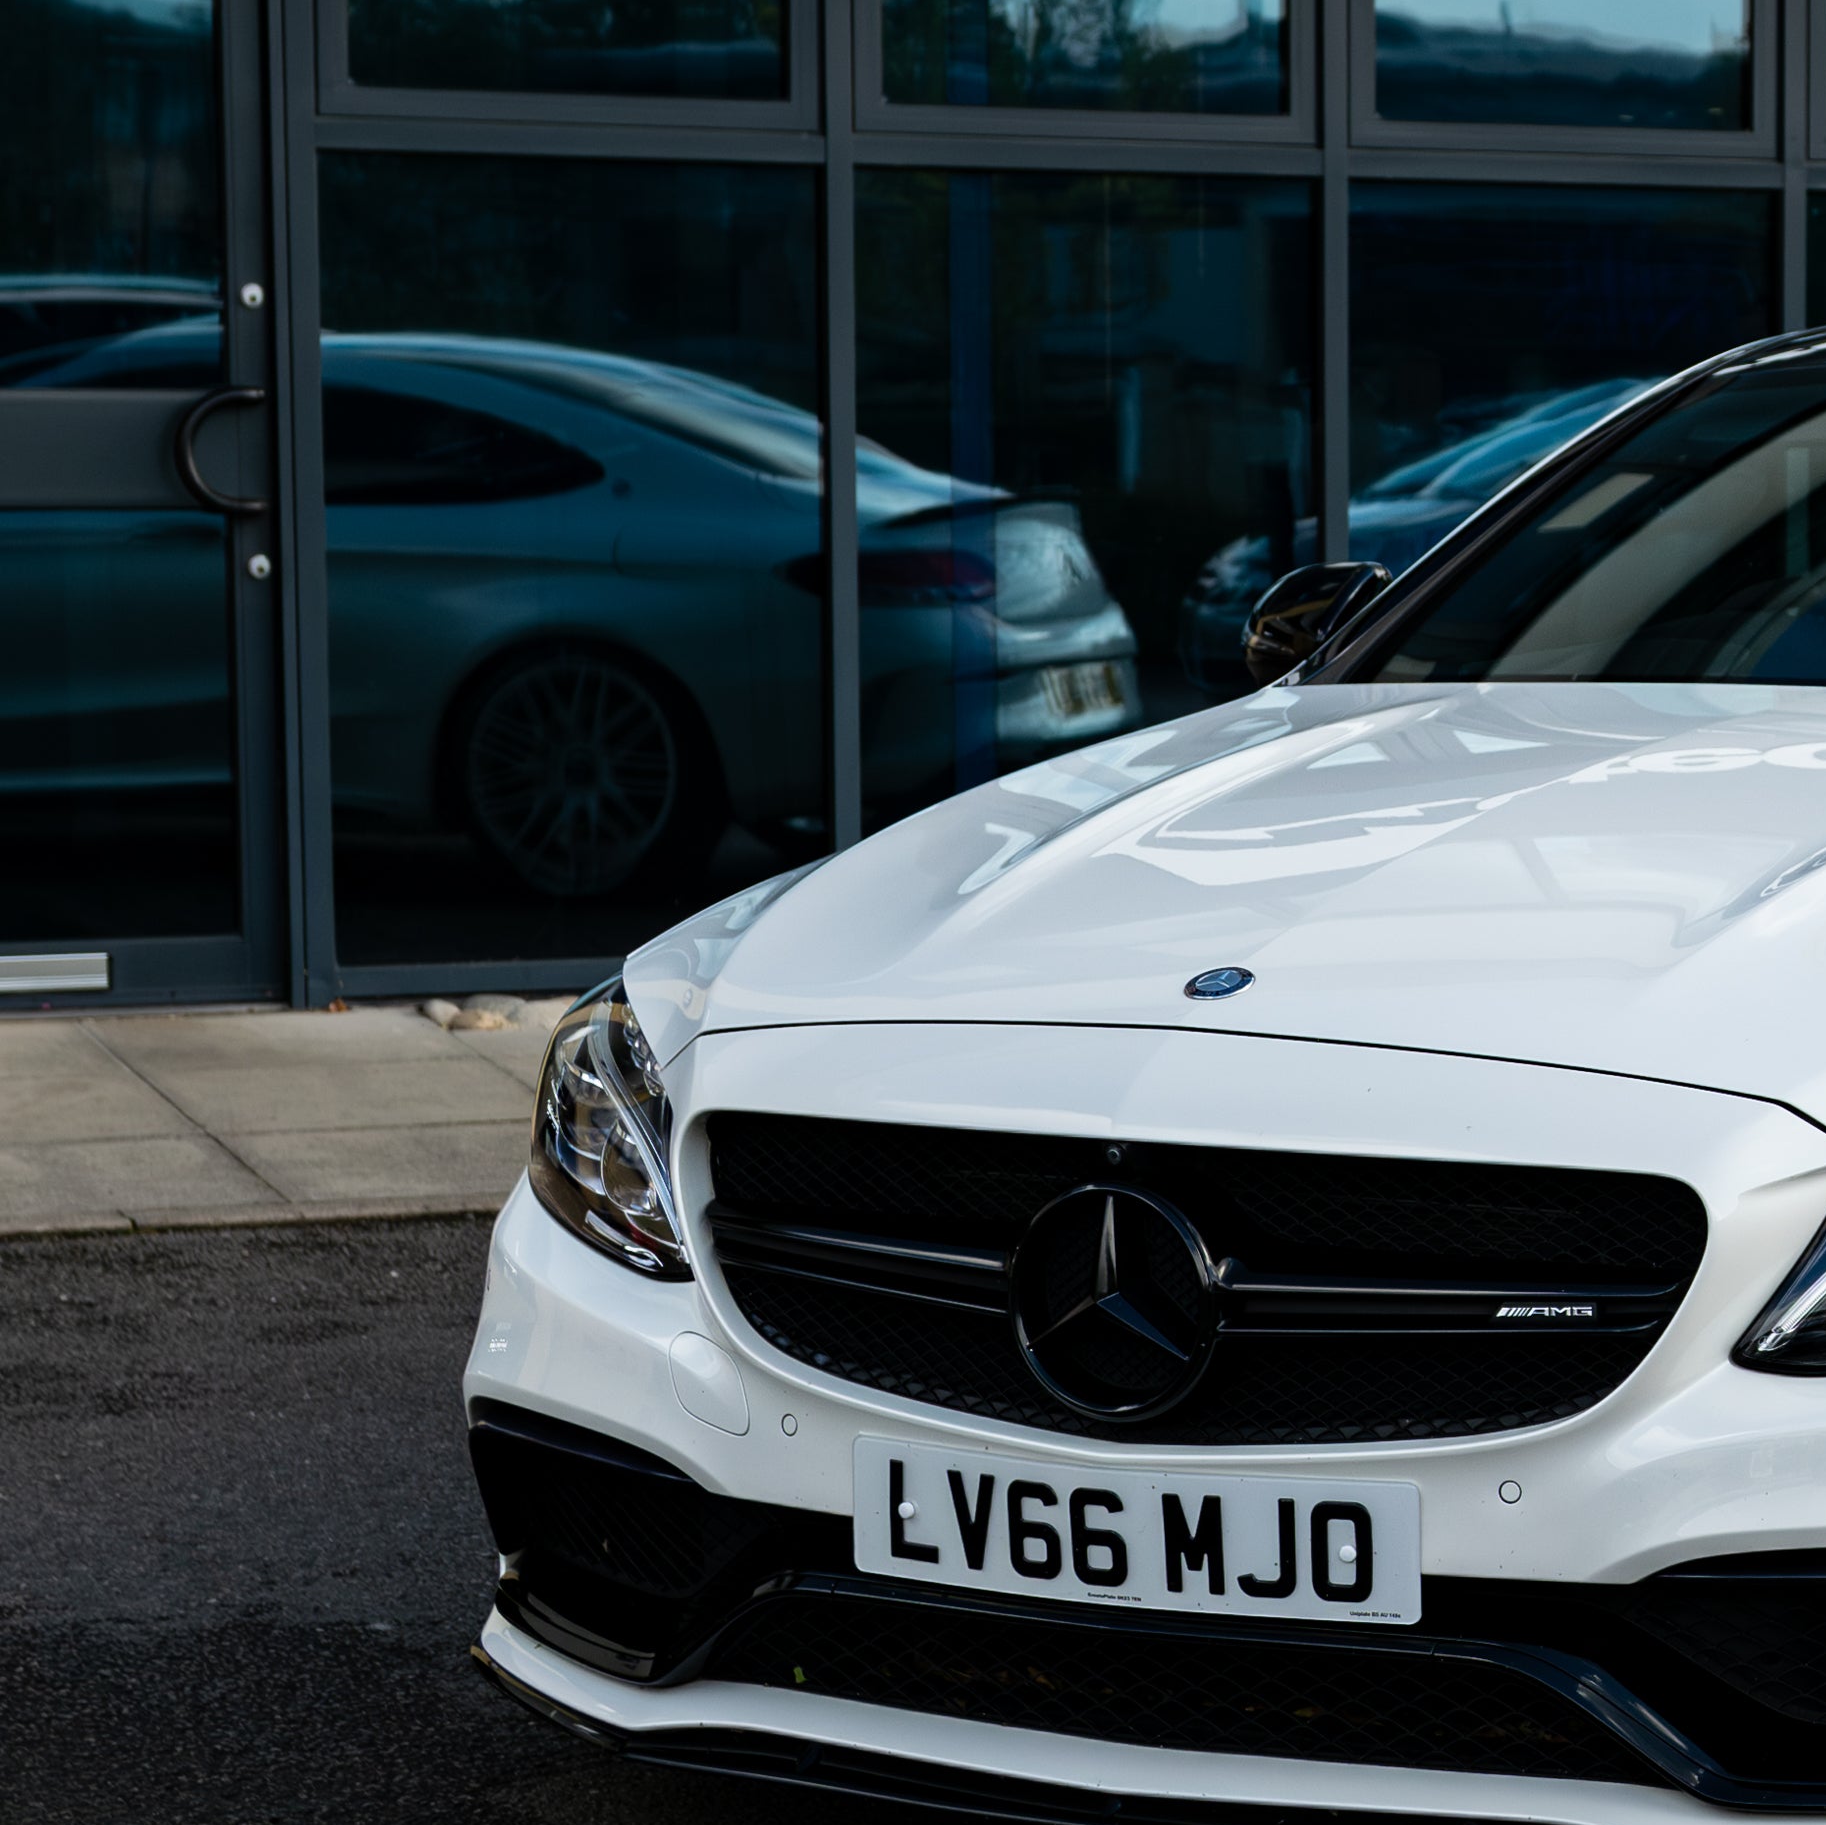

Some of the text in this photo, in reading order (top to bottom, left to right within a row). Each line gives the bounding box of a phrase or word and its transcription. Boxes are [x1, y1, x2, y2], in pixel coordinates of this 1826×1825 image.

[1527, 1306, 1593, 1317] AMG
[889, 1458, 1373, 1603] LV66 MJO
